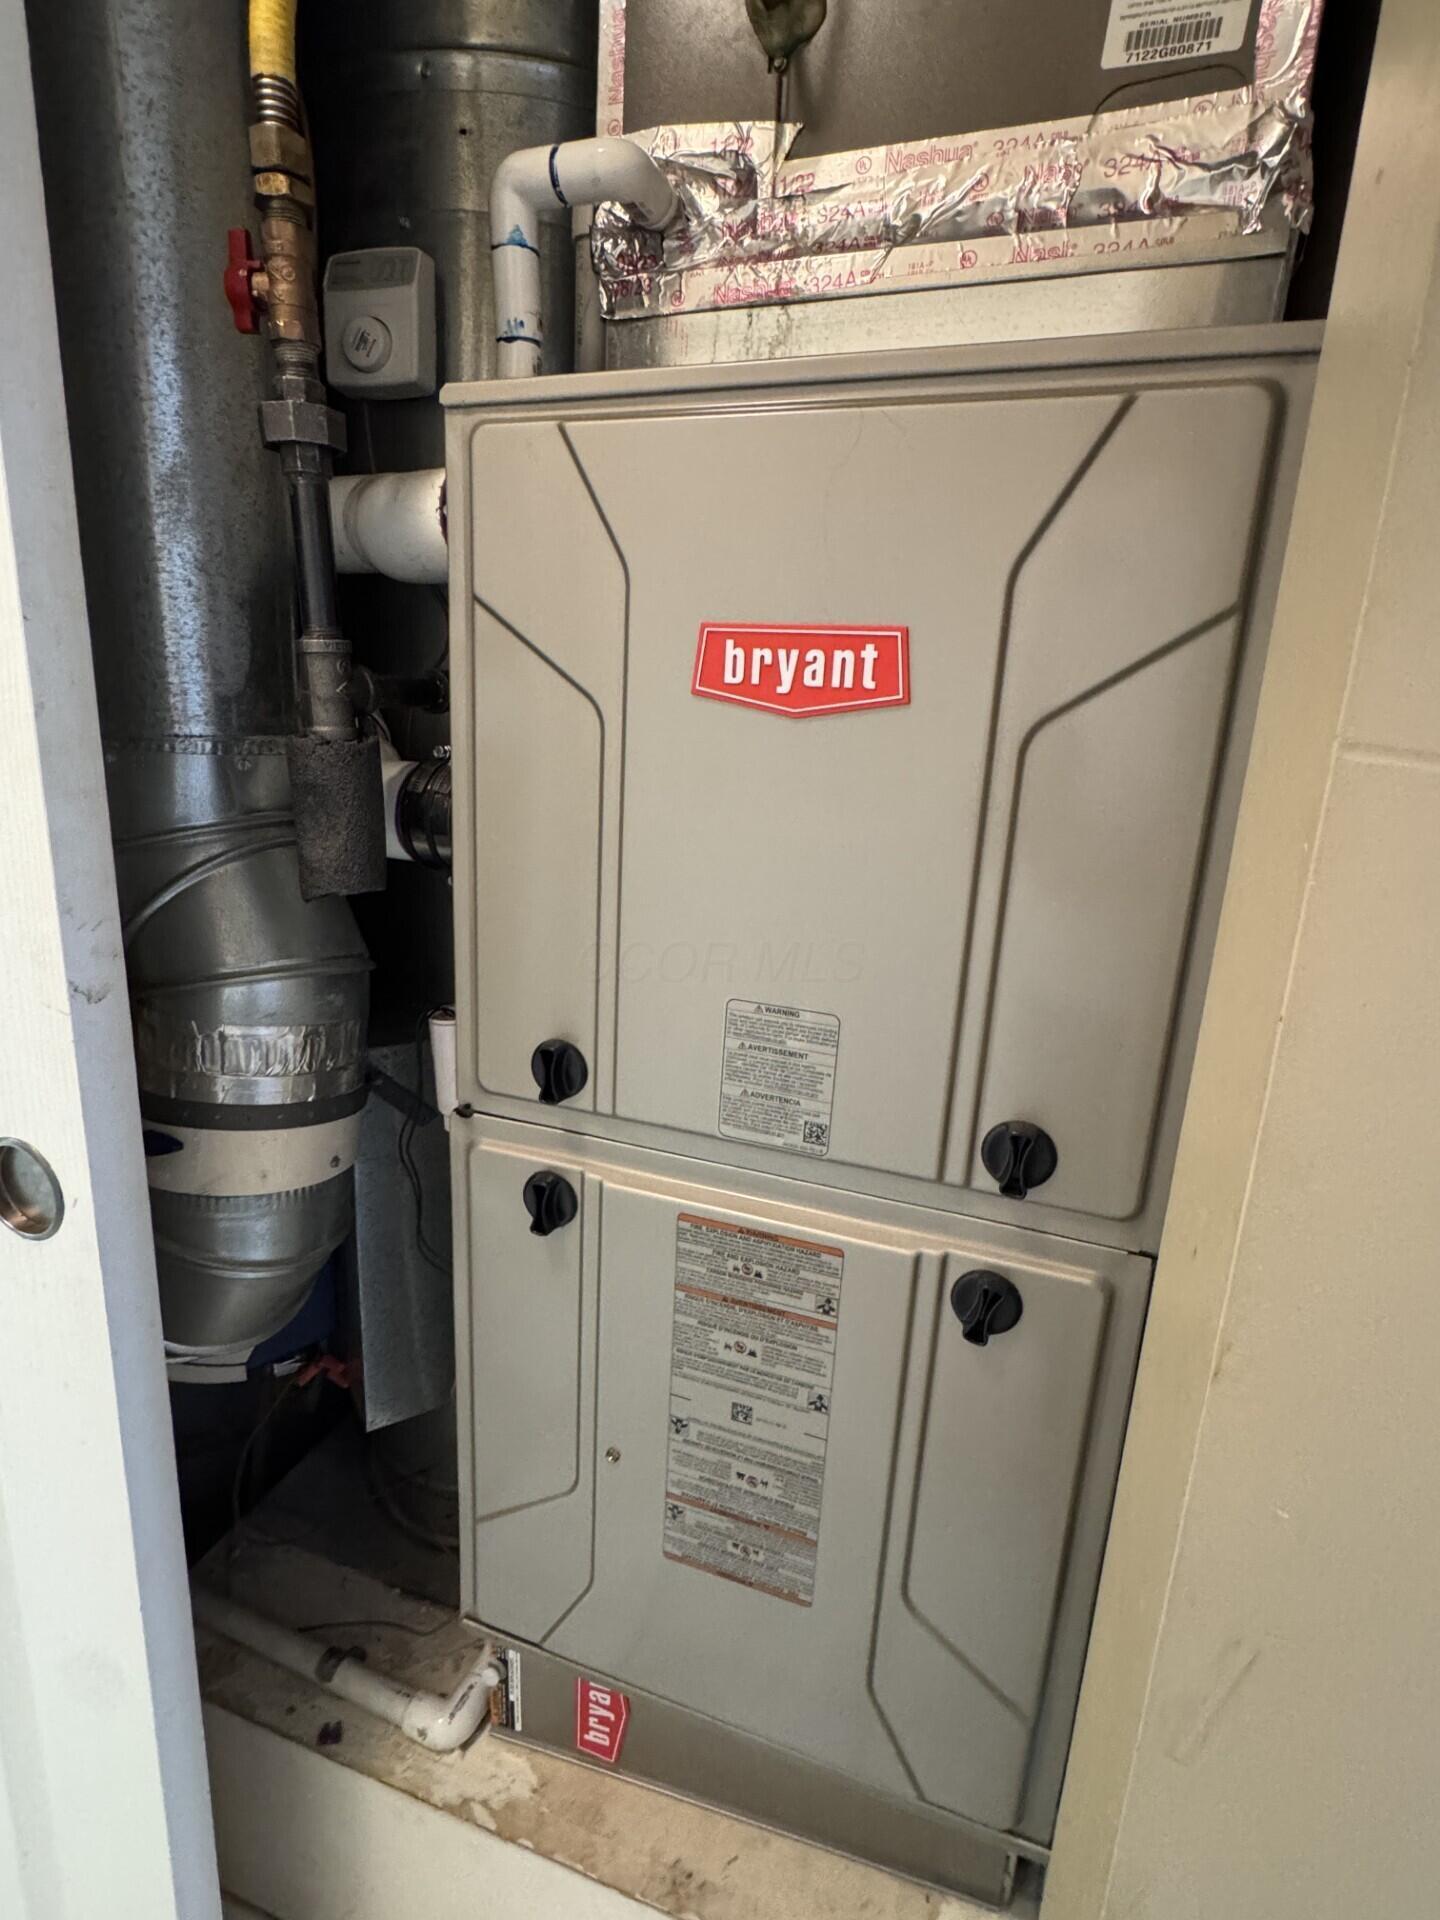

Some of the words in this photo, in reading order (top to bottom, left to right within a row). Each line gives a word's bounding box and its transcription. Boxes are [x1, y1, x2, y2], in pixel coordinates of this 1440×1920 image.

[1126, 40, 1212, 63] 7122G80871
[885, 143, 975, 174] Nashua
[724, 638, 879, 695] bryant
[765, 1005, 800, 1018] WARNING
[747, 1043, 808, 1060] AVERTISSEMENT
[750, 1091, 801, 1106] ADVERTENCIA
